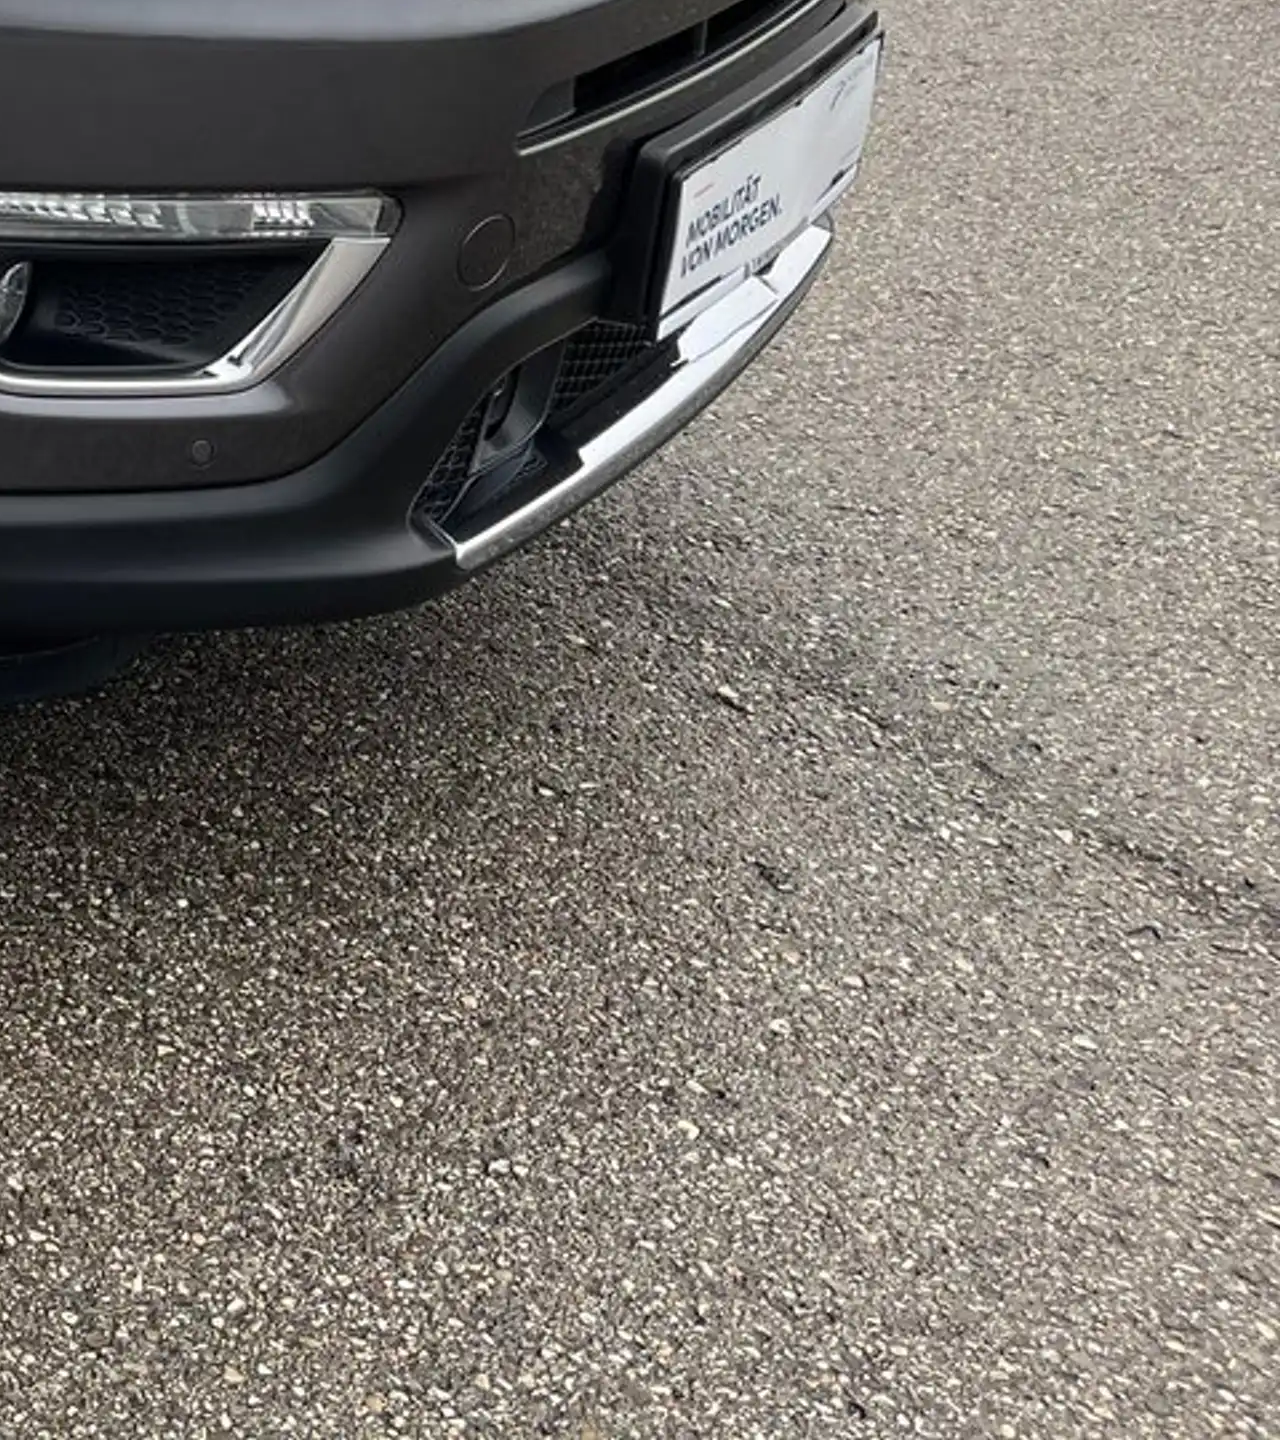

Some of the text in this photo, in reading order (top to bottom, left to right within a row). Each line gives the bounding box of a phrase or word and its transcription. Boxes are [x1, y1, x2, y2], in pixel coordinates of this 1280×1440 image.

[680, 237, 714, 278] VON
[712, 194, 784, 259] MORGEN.
[686, 174, 762, 246] MOBILITÄT
